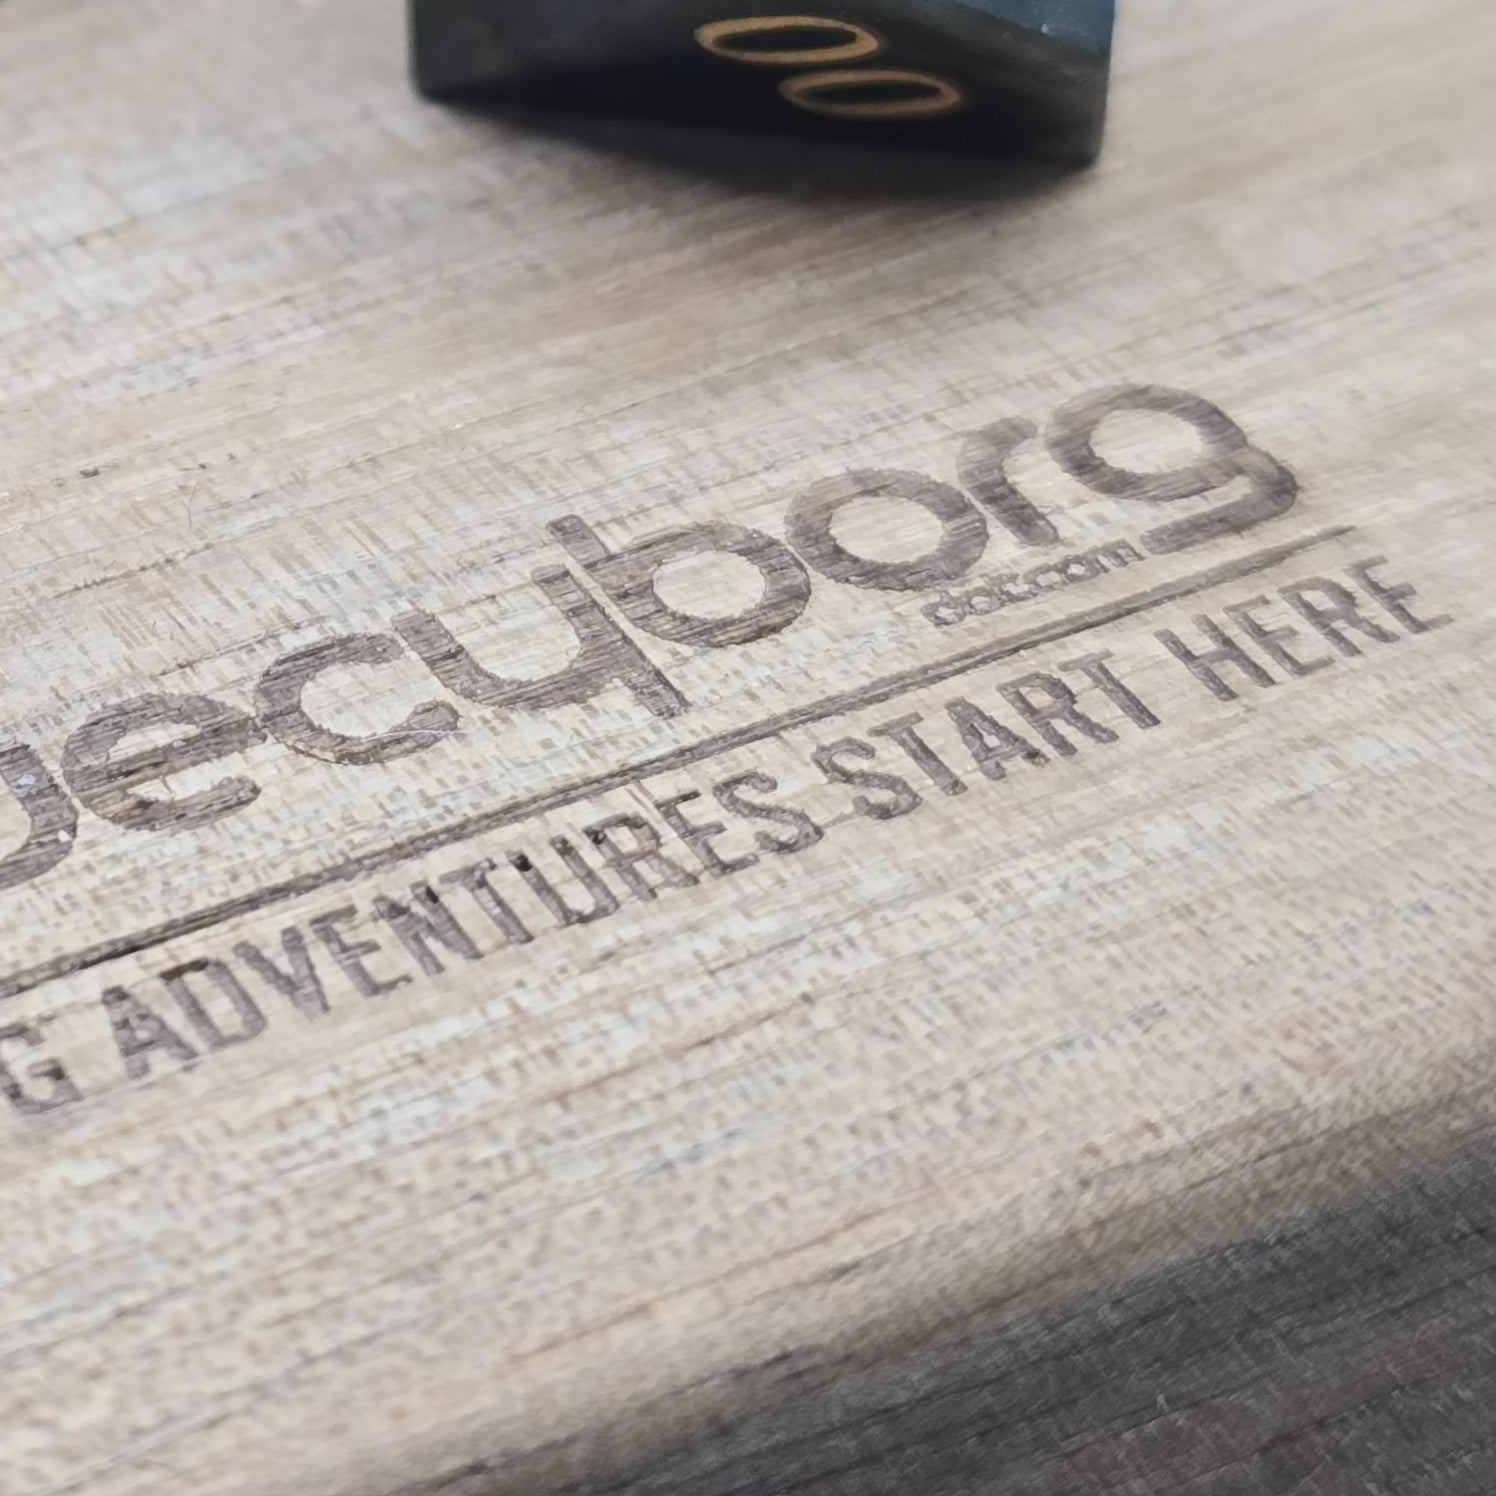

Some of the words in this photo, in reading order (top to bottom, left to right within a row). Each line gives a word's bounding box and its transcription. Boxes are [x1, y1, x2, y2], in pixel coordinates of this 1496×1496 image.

[102, 768, 826, 1081] ADVENTURES
[811, 648, 1164, 822] START
[1153, 554, 1454, 704] HERE
